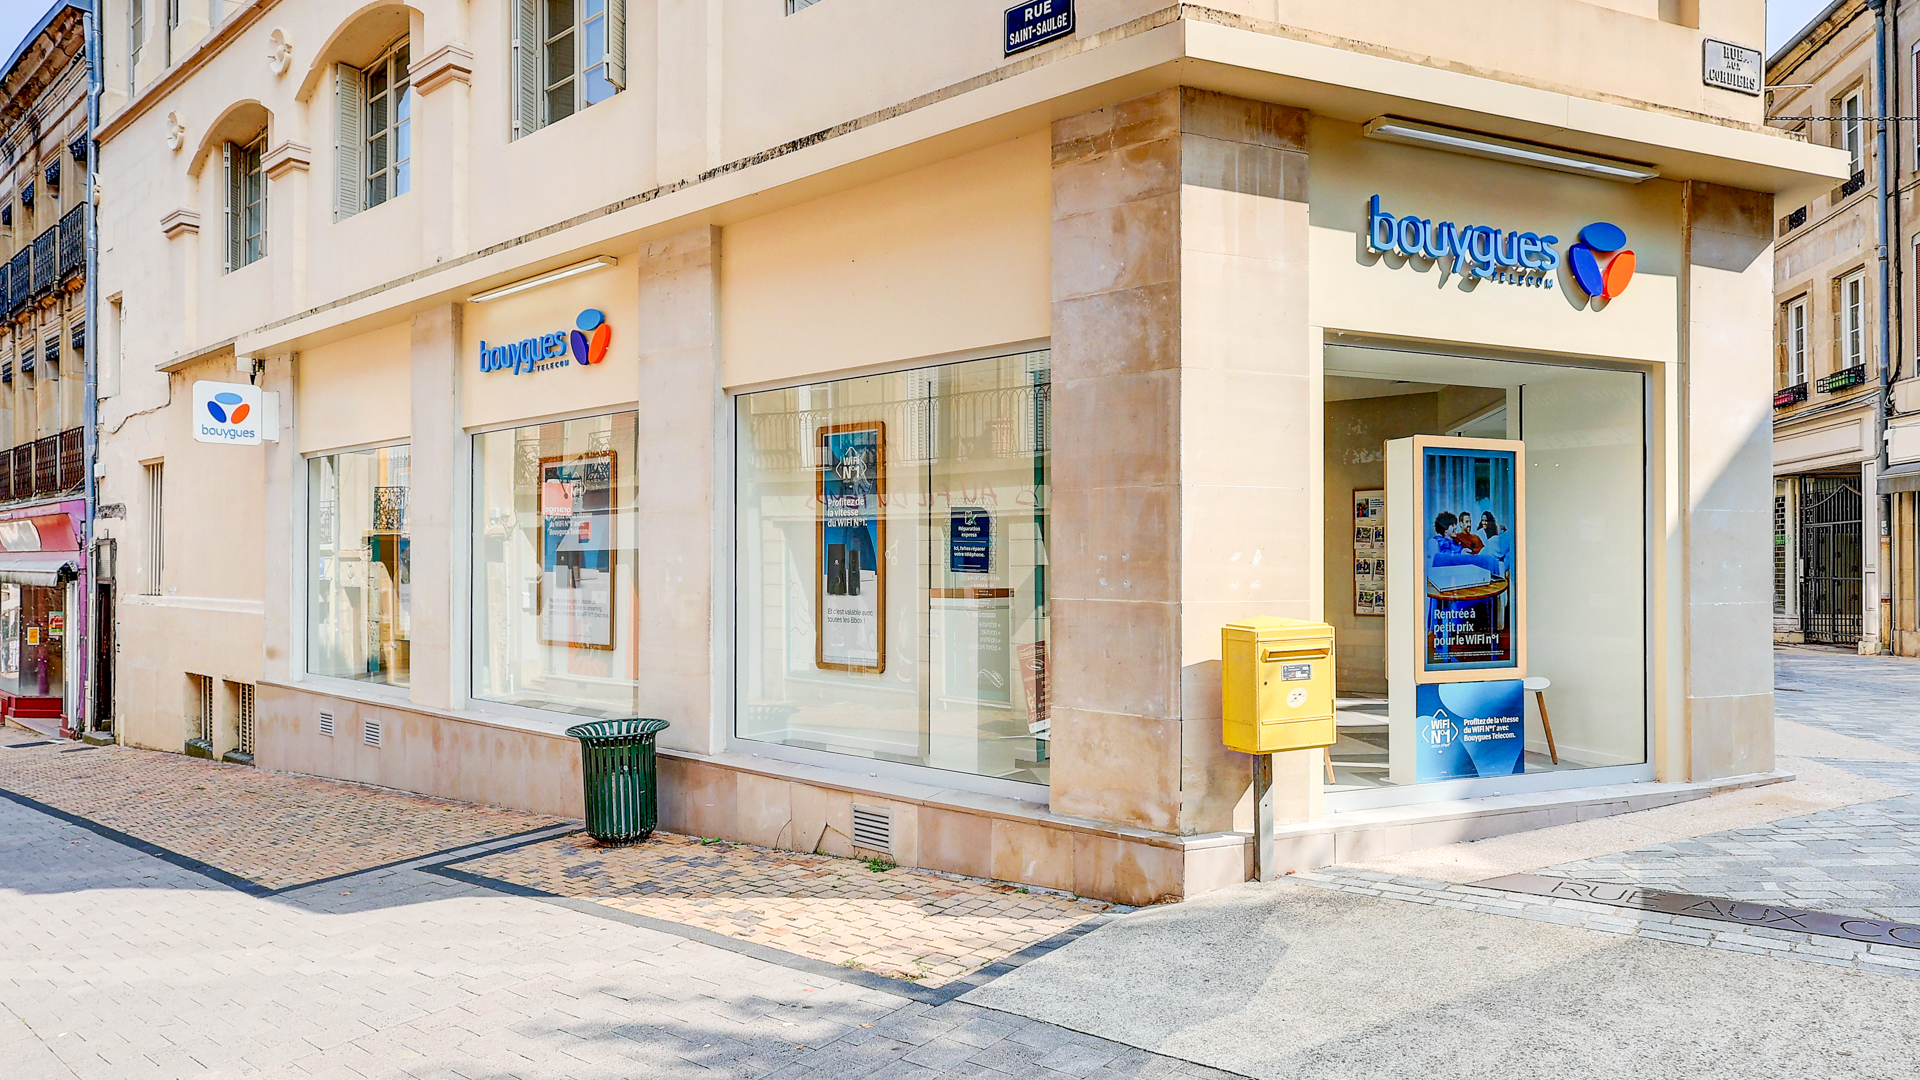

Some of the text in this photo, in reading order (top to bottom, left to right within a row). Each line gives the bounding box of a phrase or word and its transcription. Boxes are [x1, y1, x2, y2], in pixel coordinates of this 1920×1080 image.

[1025, 0, 1052, 22] RUE
[1010, 12, 1068, 46] SAINT-SAULGE
[1723, 46, 1743, 62] RUE
[1708, 68, 1755, 90] CORDIERS
[1370, 194, 1560, 278] bouygues
[1491, 271, 1554, 290] TELECOM
[480, 330, 568, 376] bouygues
[536, 359, 570, 372] TELECOM
[202, 424, 255, 440] bouygues
[843, 456, 860, 465] WiFi
[842, 466, 860, 479] N°1
[828, 497, 865, 507] Profitez de
[828, 508, 858, 517] la vitesse
[828, 518, 836, 528] du
[1434, 608, 1476, 619] Rentrée à
[1434, 621, 1474, 635] petit prix
[1434, 634, 1499, 648] pour le WiFi n°1
[1431, 718, 1450, 730] WiFi
[1463, 717, 1486, 726] Profitez
[1431, 729, 1451, 744] N°1
[1463, 734, 1491, 742] Bouygues
[1551, 881, 1667, 908] RUE
[1681, 900, 1808, 928] AUX
